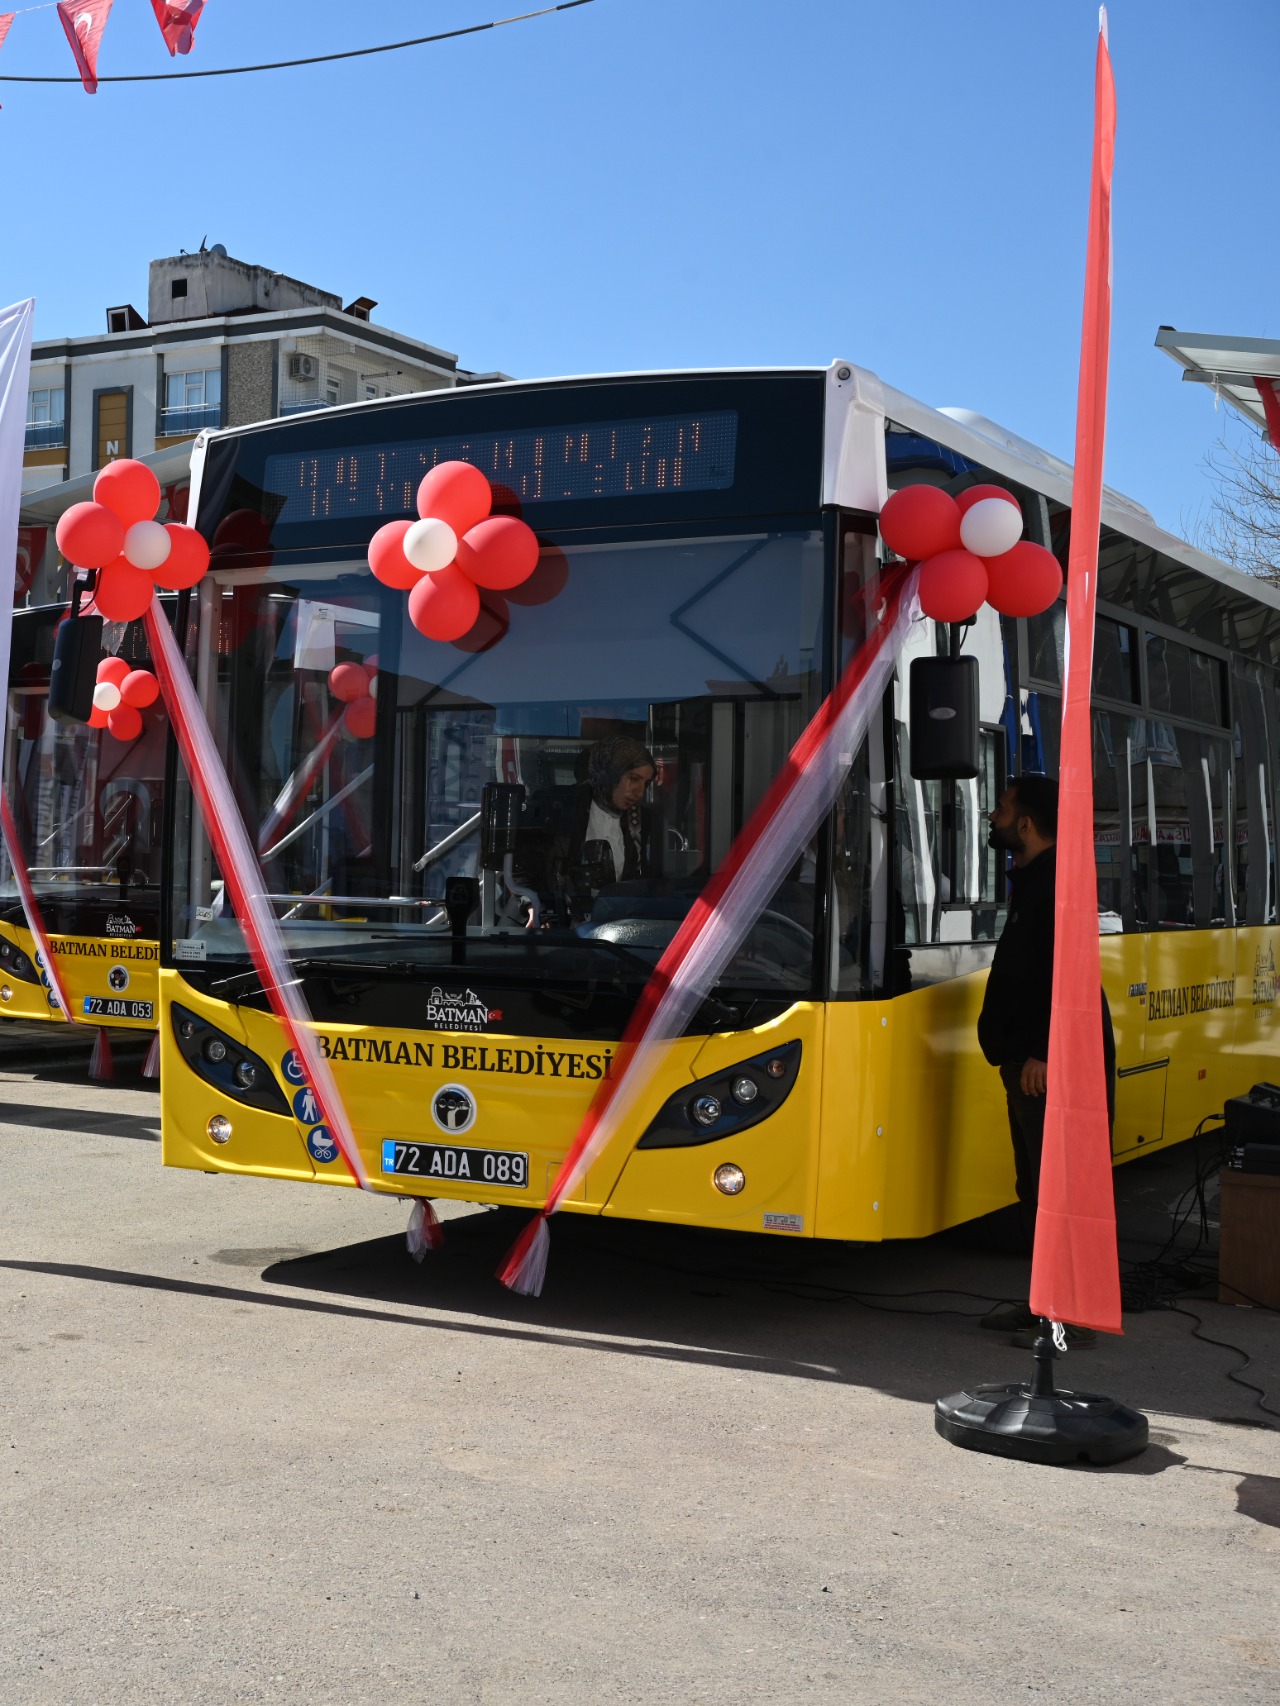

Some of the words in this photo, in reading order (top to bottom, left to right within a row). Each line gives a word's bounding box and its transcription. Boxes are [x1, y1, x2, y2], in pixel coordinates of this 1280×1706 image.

[106, 923, 135, 934] BATMAN
[50, 940, 107, 957] BATMAN
[110, 944, 160, 960] BELEDİ
[90, 999, 103, 1013] 72
[107, 1001, 127, 1016] ADA
[132, 1002, 151, 1018] 053
[1148, 986, 1190, 1020] BATMAN
[426, 1005, 488, 1023] BATMAN
[434, 1022, 482, 1031] BELEDİYESİ
[315, 1035, 435, 1067] BATMAN
[442, 1044, 613, 1080] BELEDİYESİ
[384, 1157, 393, 1166] TR
[395, 1145, 420, 1172] 72
[429, 1150, 471, 1177] ADA
[483, 1153, 524, 1183] 089
